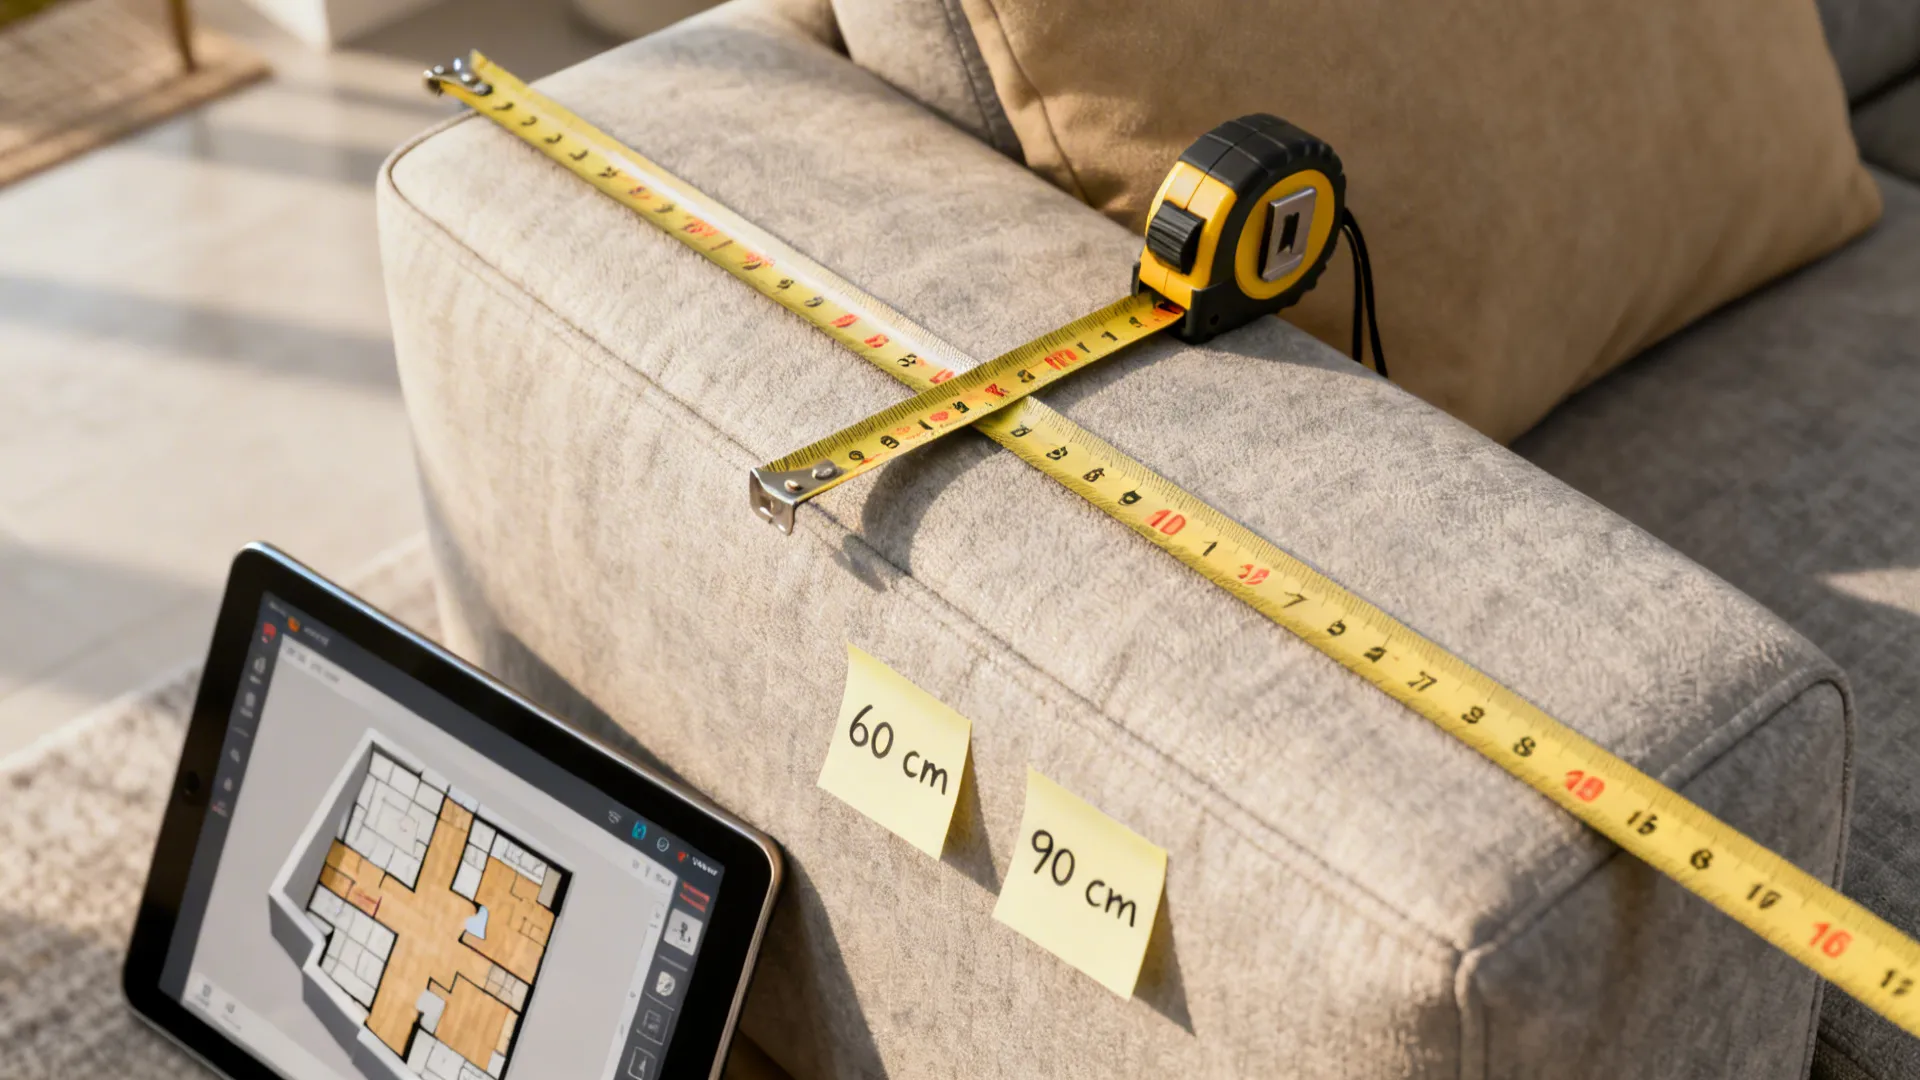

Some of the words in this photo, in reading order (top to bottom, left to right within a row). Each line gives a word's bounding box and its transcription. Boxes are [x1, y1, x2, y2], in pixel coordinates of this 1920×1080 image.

[848, 703, 894, 759] 60
[902, 750, 948, 796] cm
[1030, 829, 1076, 887] 90
[1085, 879, 1138, 928] cm
[1512, 736, 1536, 757] 8
[1808, 922, 1853, 958] 16
